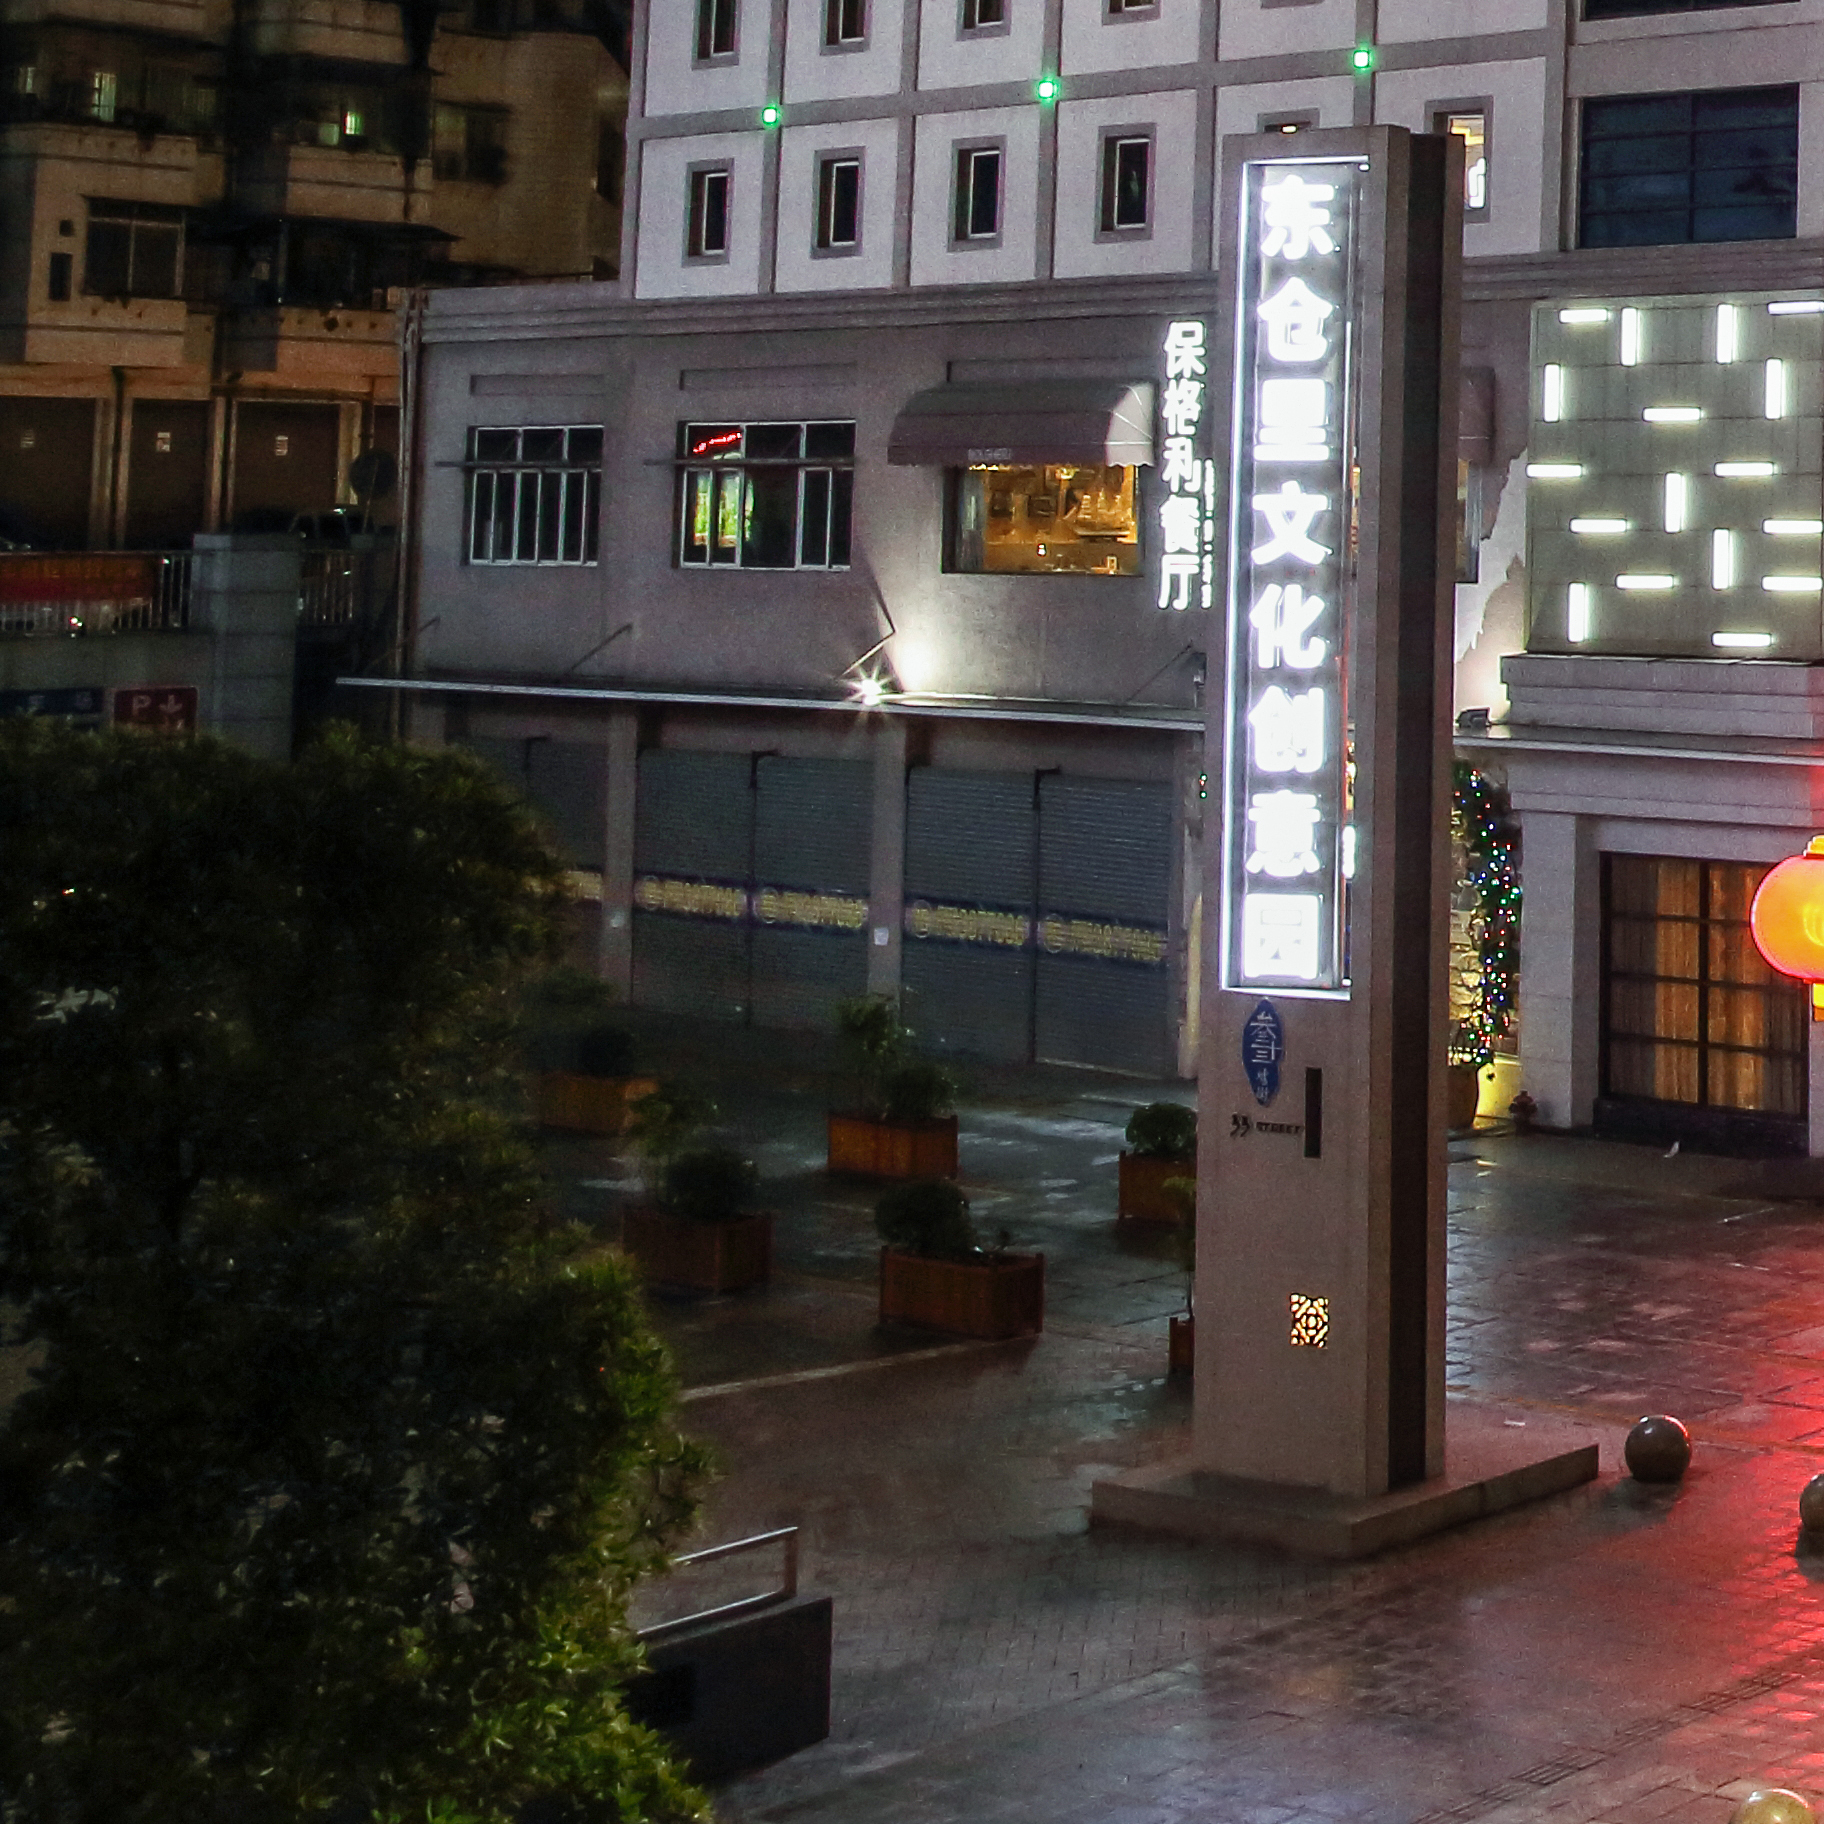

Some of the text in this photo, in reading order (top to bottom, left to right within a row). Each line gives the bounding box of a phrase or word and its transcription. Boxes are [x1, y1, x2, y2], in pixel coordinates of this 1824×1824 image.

[1244, 174, 1335, 979] 东仓里文化创意园
